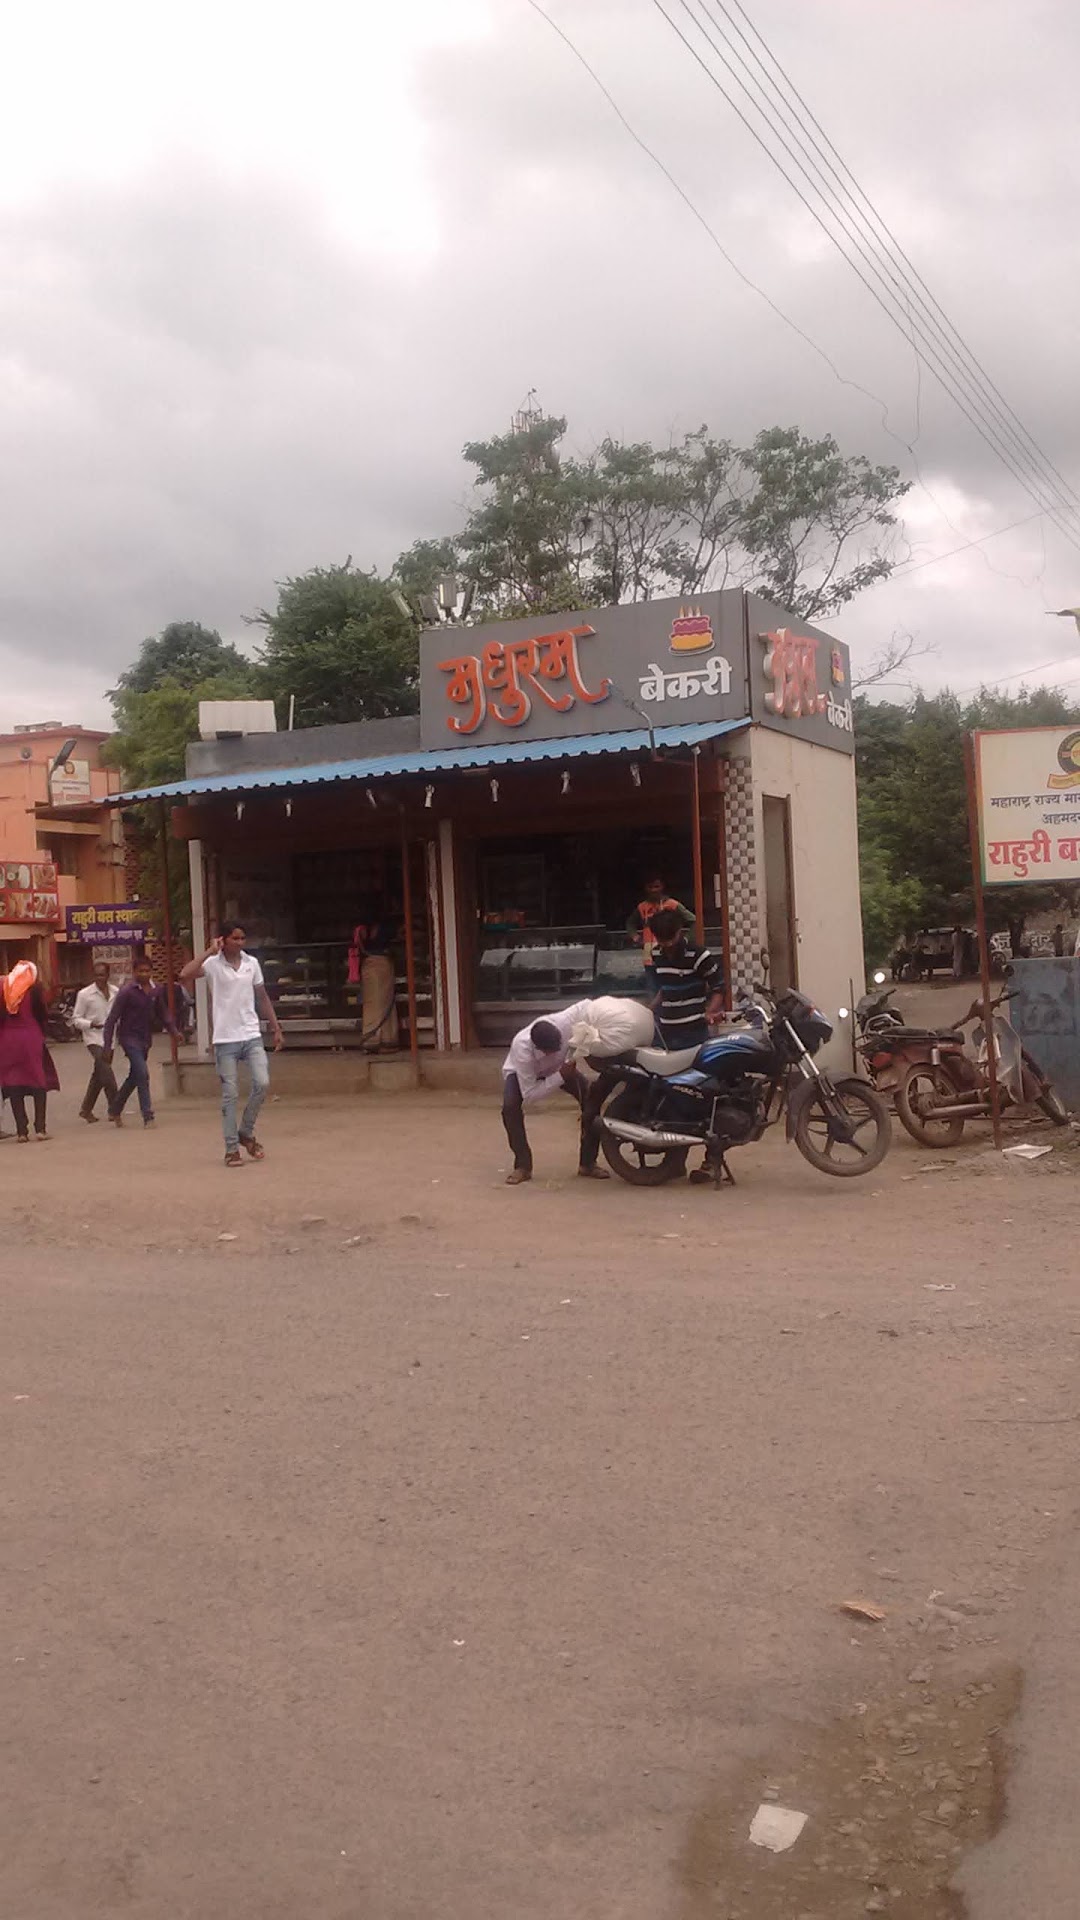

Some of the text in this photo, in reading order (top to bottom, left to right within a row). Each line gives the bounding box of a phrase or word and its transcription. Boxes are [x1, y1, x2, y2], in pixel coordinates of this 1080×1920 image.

[639, 657, 732, 702] बेकरी
[990, 795, 1031, 809] महाराष्ट्र
[1034, 794, 1061, 805] राज्य
[988, 829, 1080, 877] राहुरी ब
